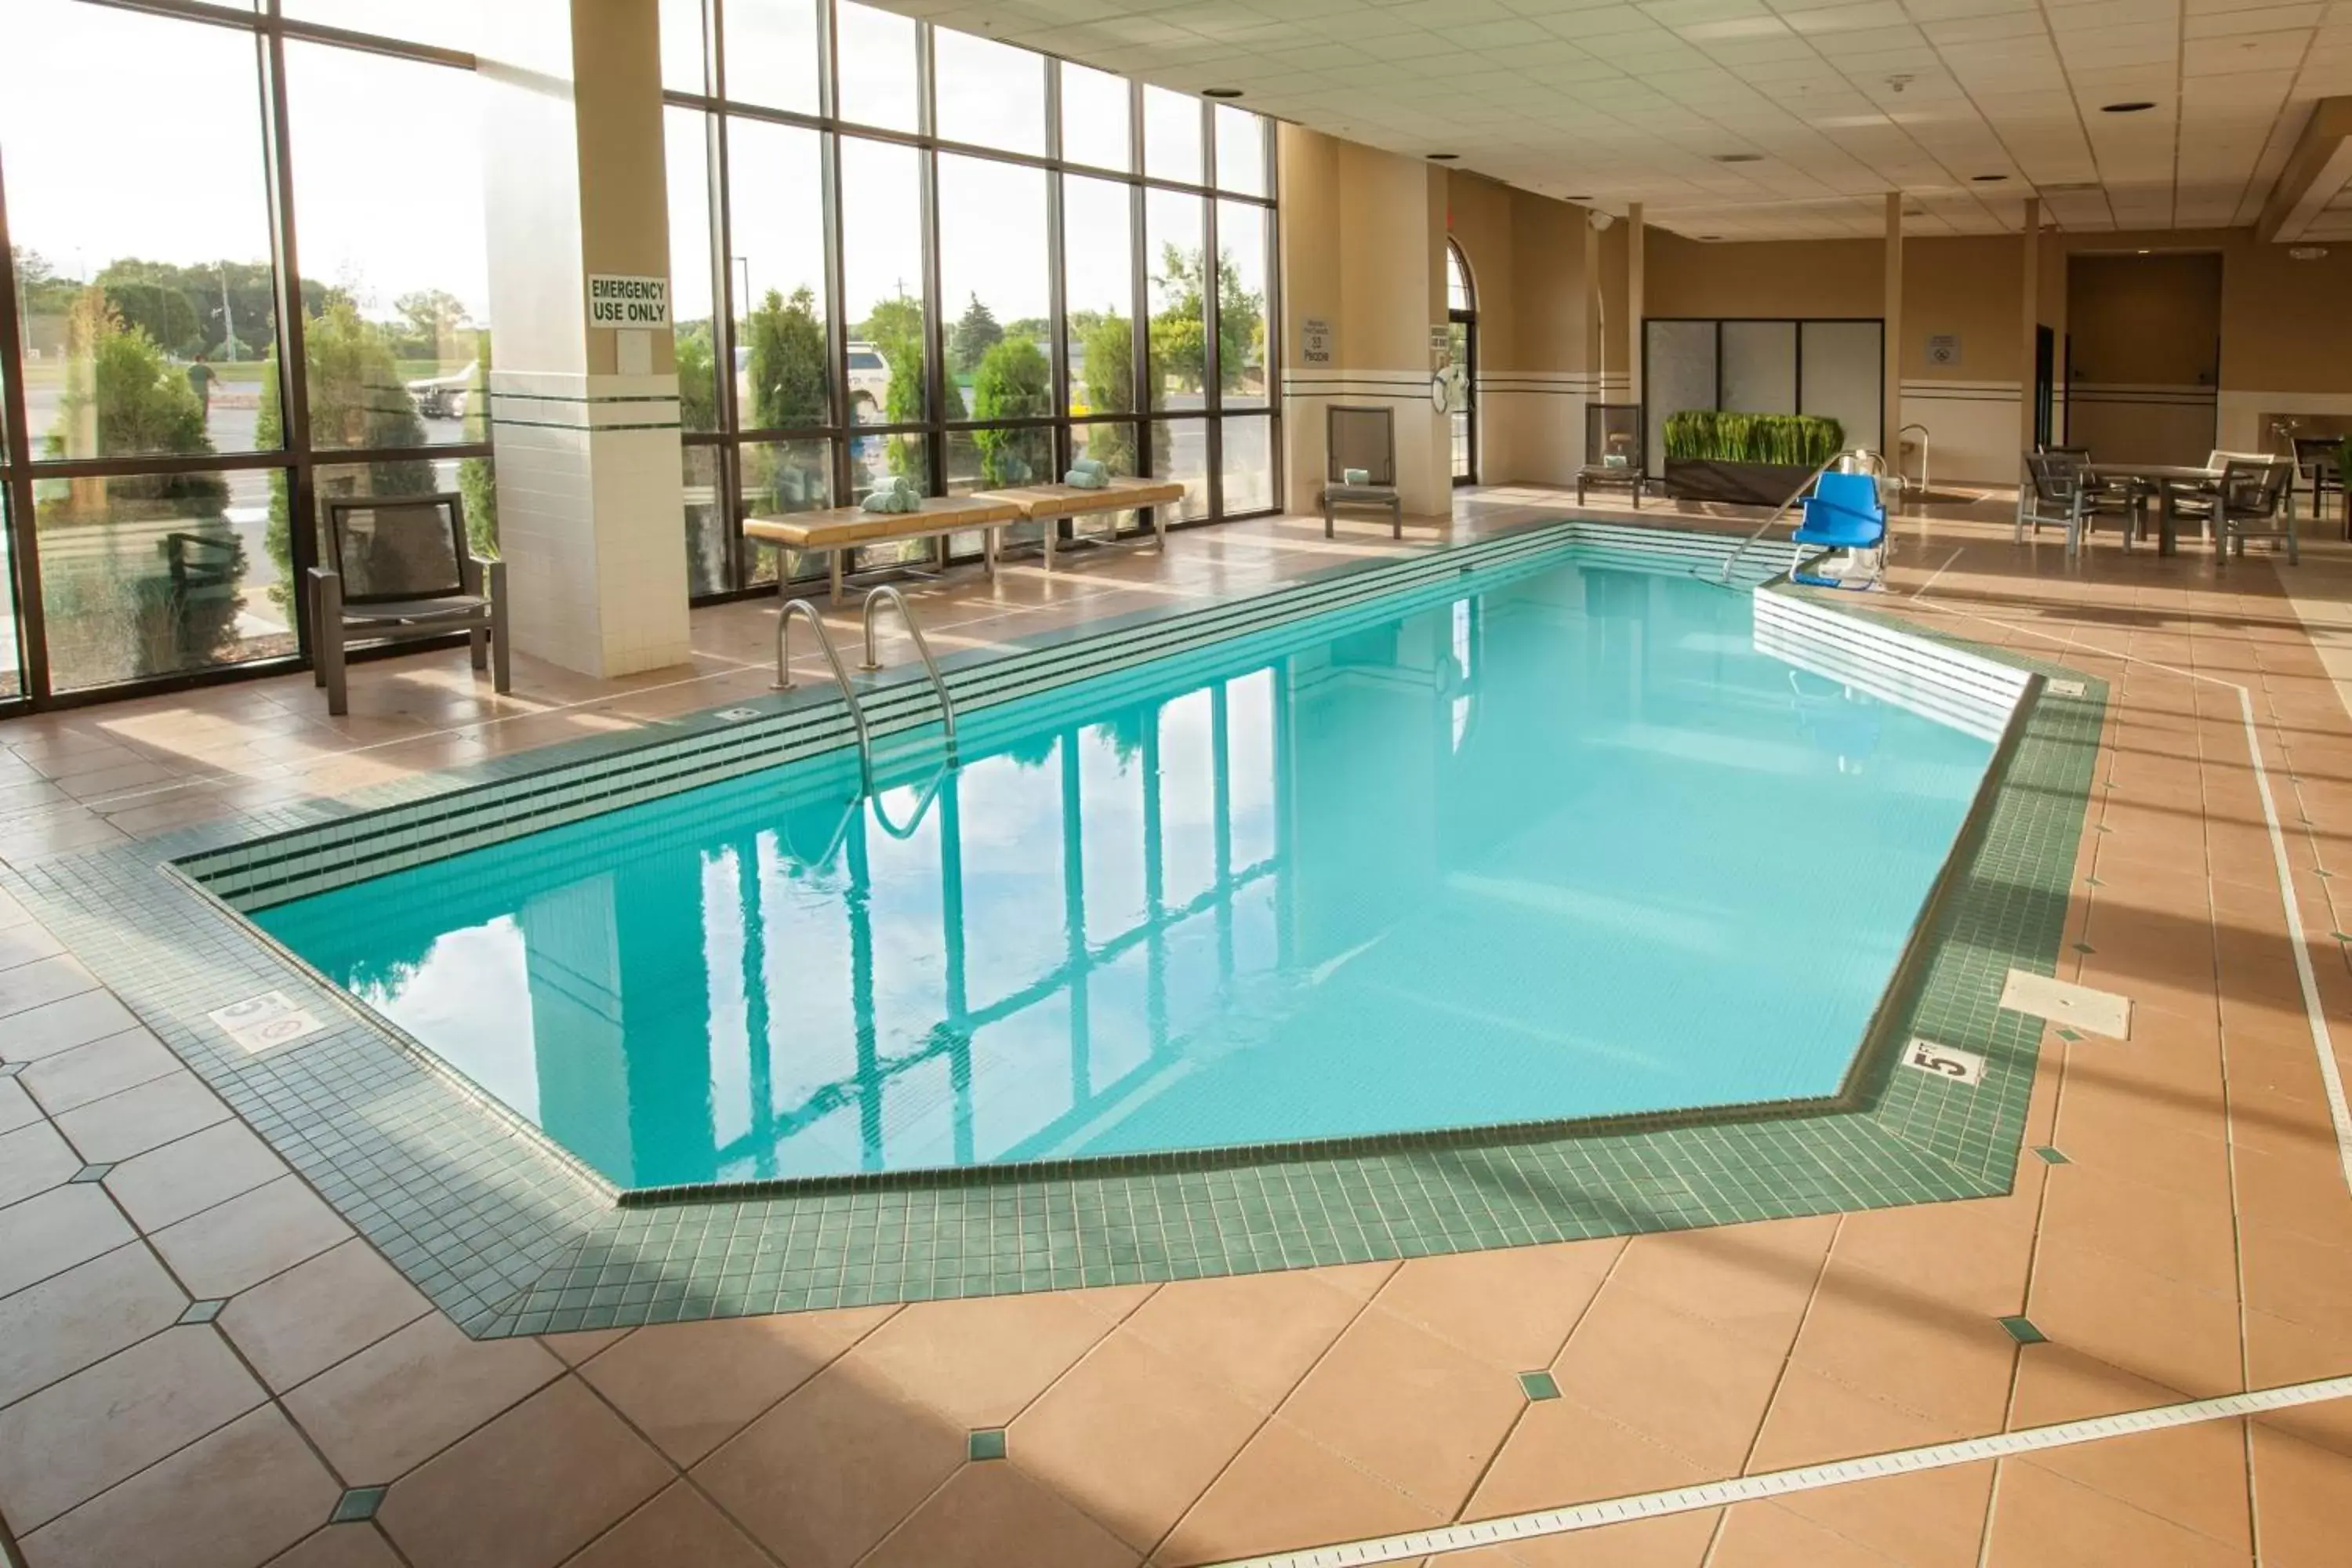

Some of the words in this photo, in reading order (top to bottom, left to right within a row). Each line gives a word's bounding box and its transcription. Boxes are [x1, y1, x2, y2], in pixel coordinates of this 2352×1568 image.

[593, 279, 664, 300] EMERGENCY
[593, 303, 623, 321] USE
[628, 303, 665, 321] ONLY
[1913, 1053, 1966, 1076] 5
